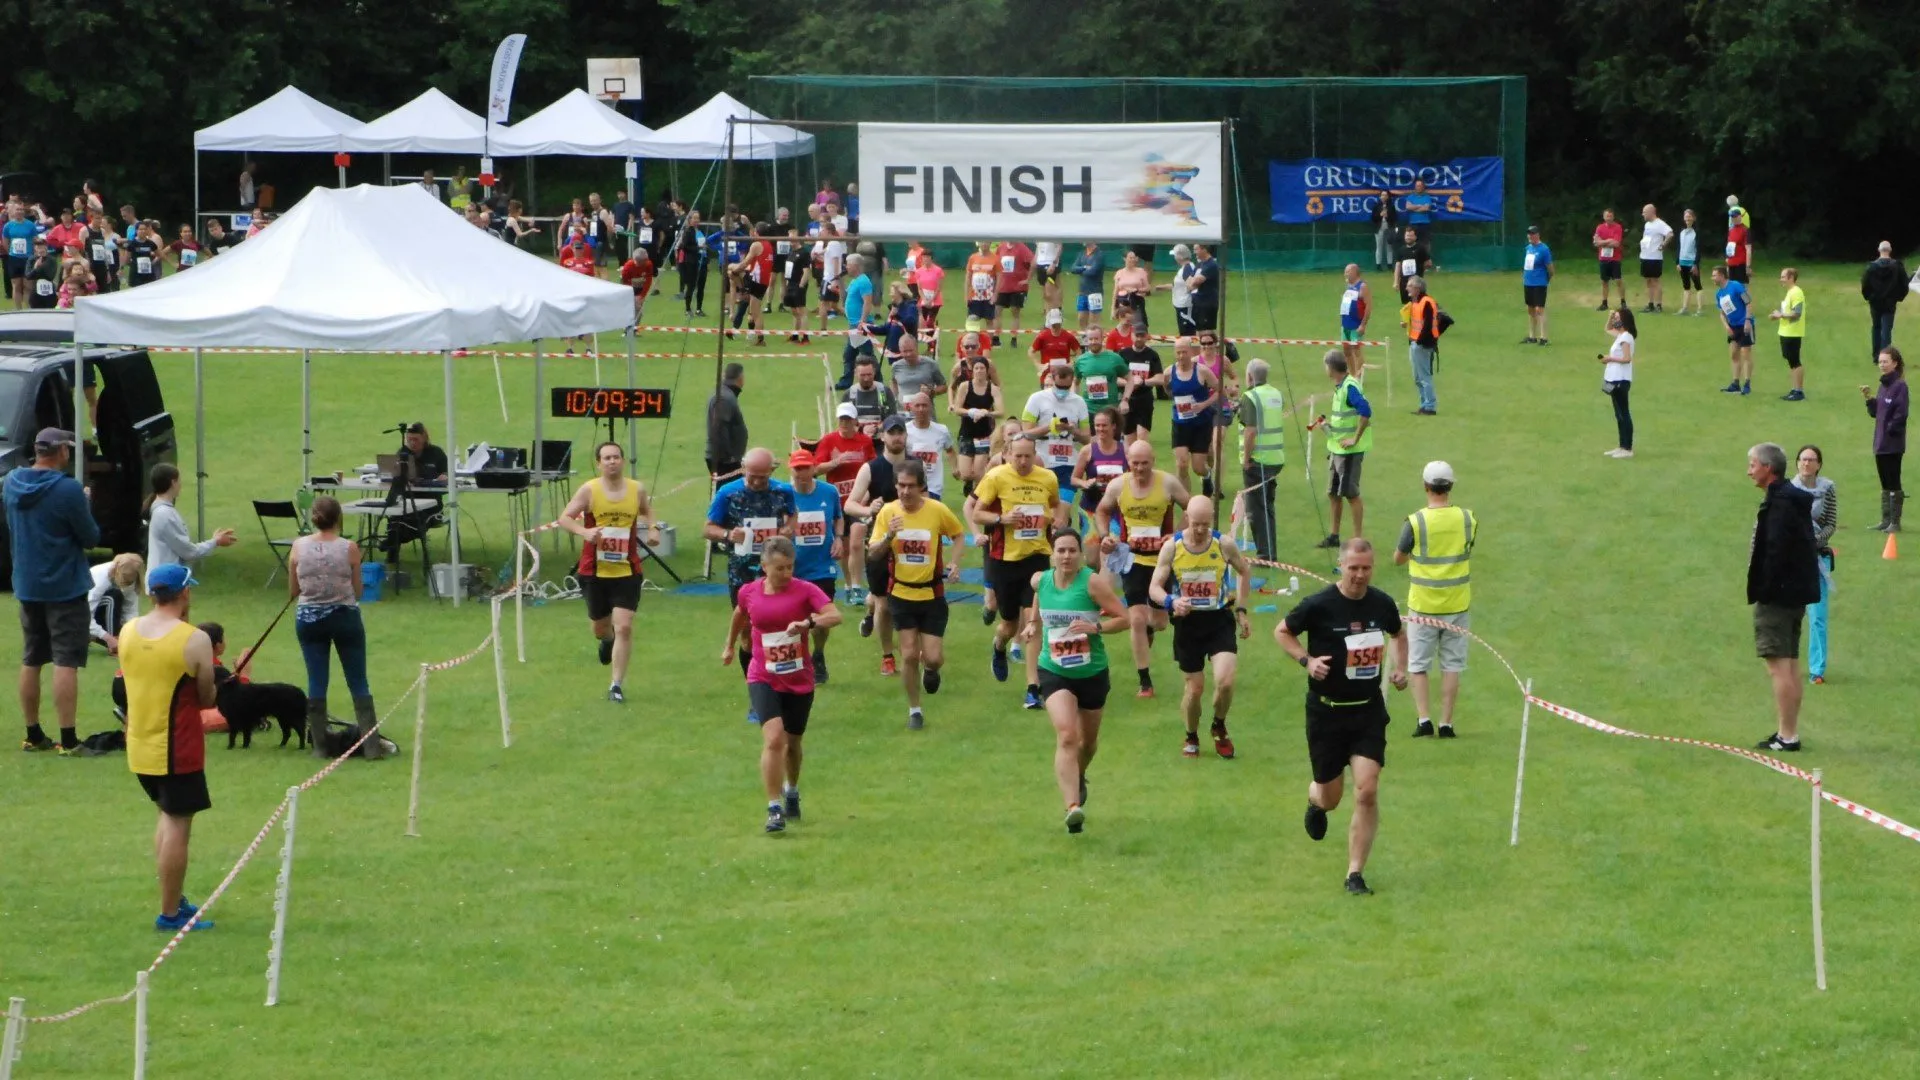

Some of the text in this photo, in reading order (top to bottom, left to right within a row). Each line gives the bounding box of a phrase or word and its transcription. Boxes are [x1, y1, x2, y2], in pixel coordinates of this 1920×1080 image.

[1304, 165, 1464, 188] GRUNDON
[884, 165, 1093, 214] FINISH
[1331, 196, 1439, 214] RECCE
[566, 390, 663, 415] 10:09:34
[800, 522, 822, 536] 685
[602, 538, 623, 552] 631
[903, 540, 926, 555] 686
[1187, 582, 1211, 598] 646
[769, 644, 797, 662] 556
[1353, 648, 1378, 666] 554
